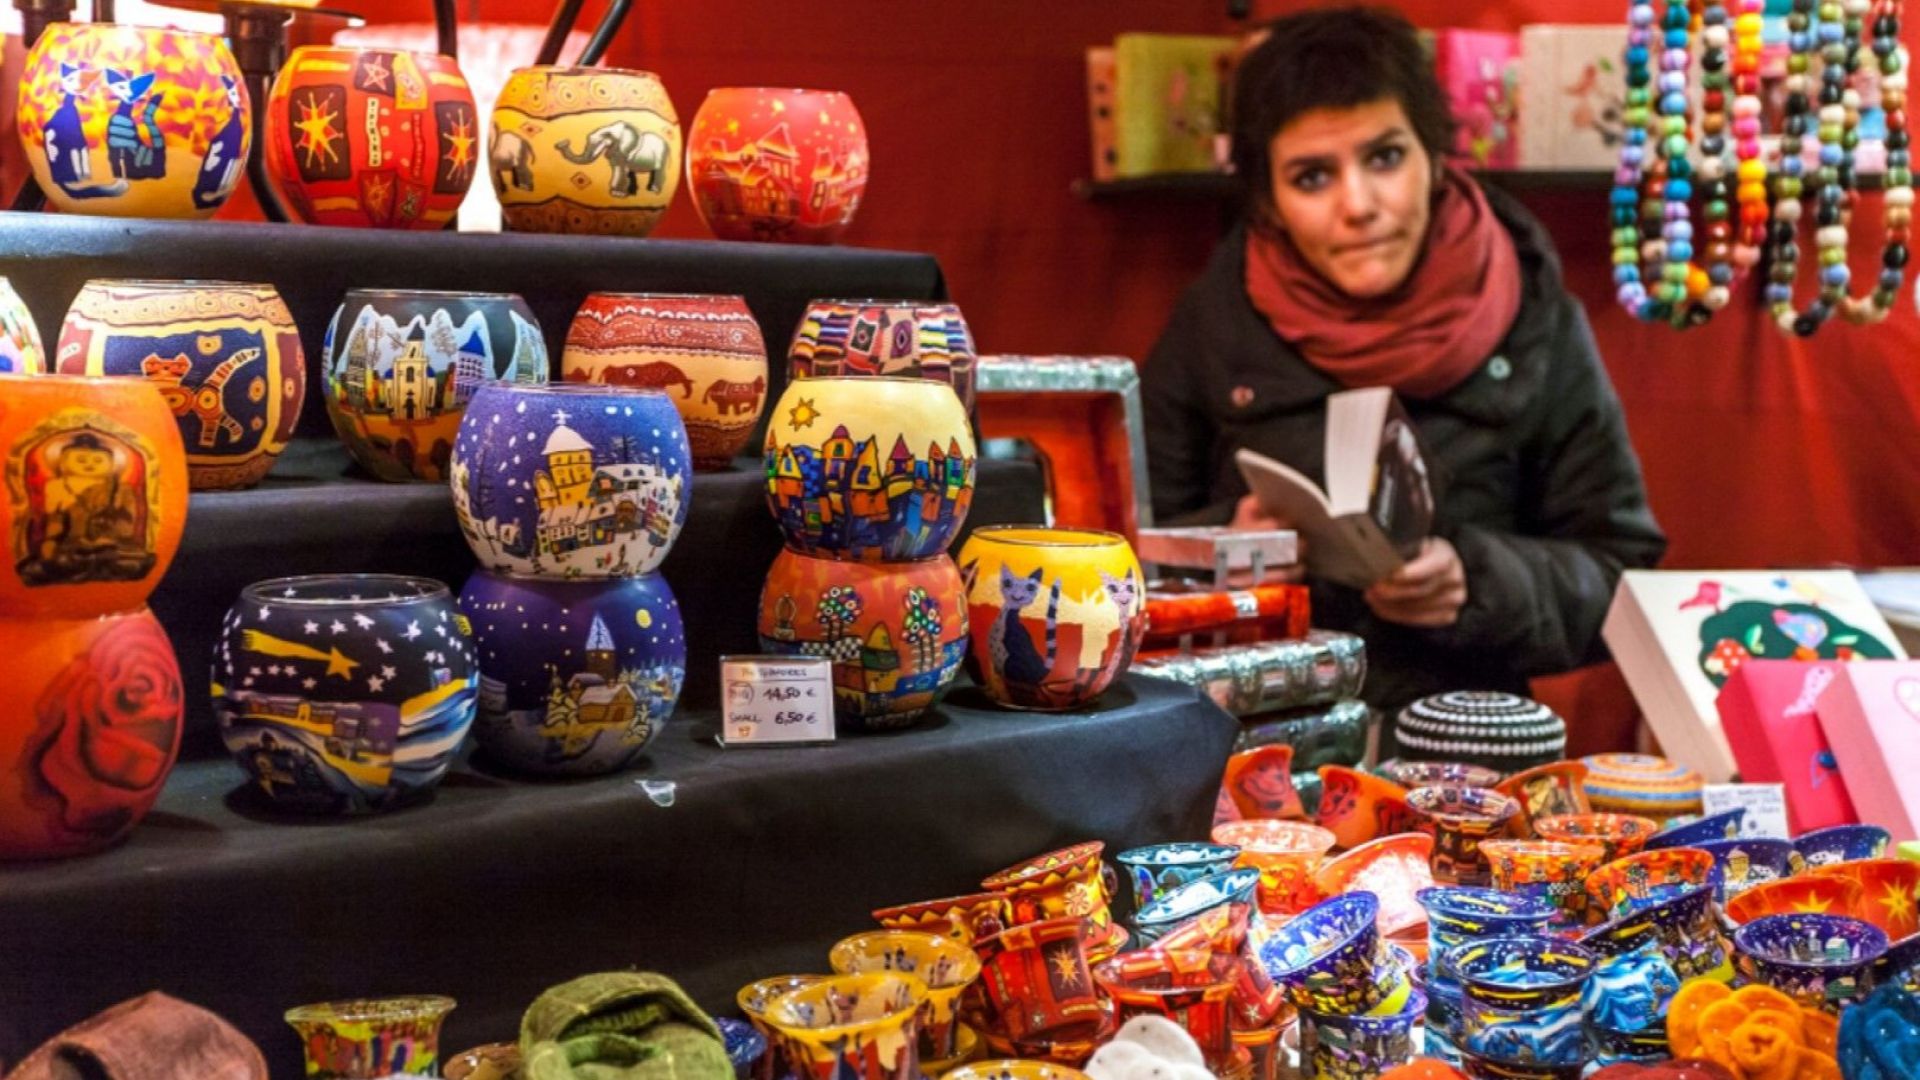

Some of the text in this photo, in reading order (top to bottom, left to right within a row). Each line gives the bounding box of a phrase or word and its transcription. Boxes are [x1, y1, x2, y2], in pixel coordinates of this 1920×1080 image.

[806, 686, 817, 697] €
[728, 711, 818, 725] SMALL 6,50 €
